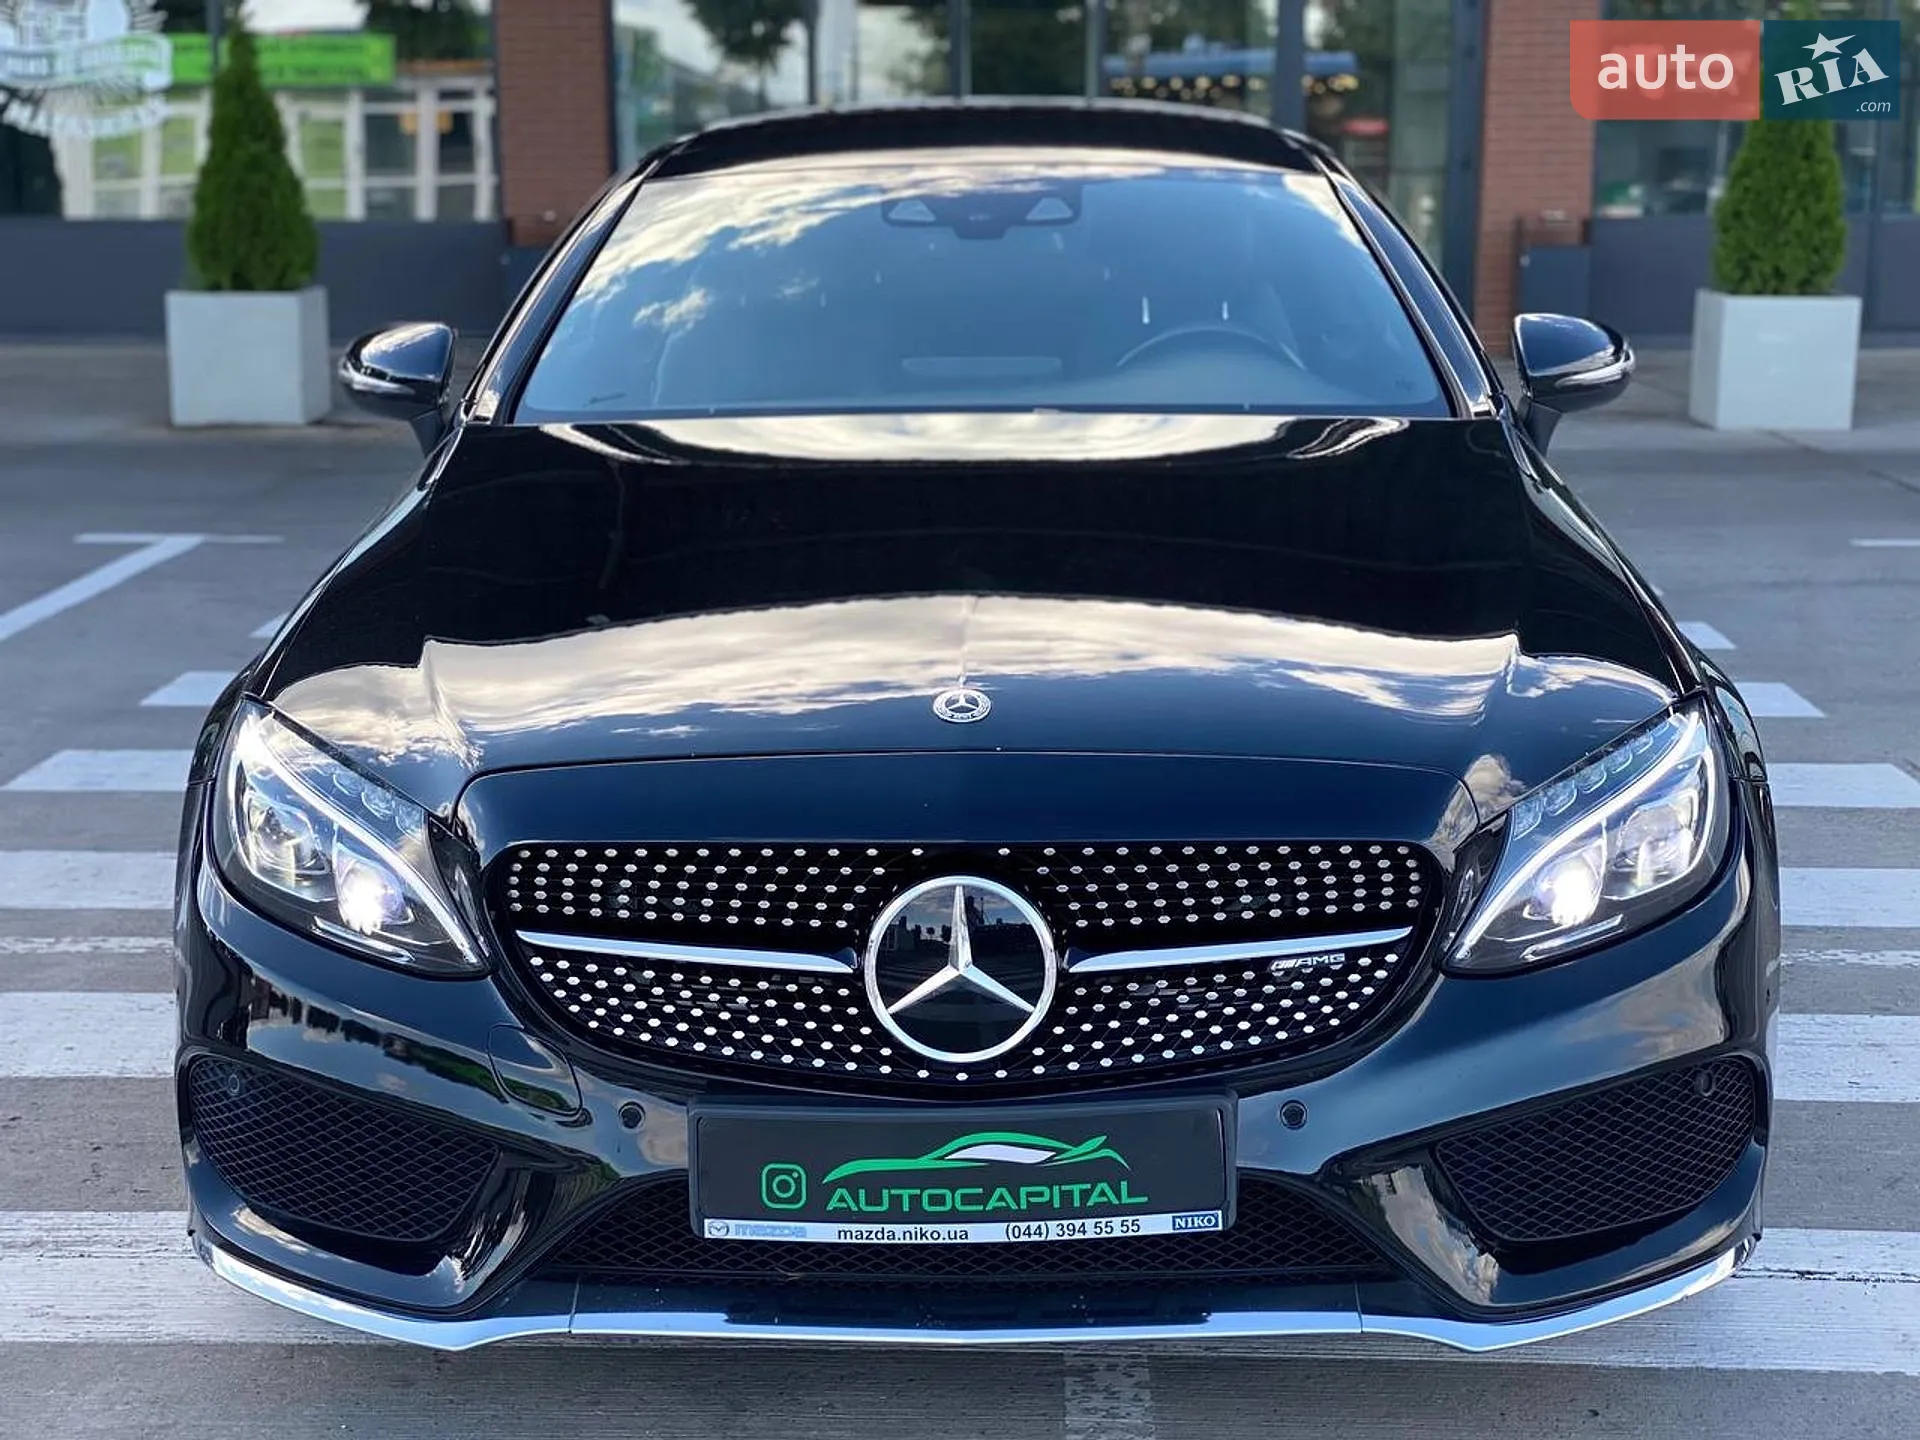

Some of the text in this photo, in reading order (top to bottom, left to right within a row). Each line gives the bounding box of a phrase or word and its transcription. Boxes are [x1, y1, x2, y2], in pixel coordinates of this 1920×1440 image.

[827, 1181, 1148, 1212] AUTOCAPITAL
[1004, 1218, 1141, 1241] (044) 394 55 55
[1174, 1214, 1217, 1230] NIKO
[837, 1226, 969, 1242] mazda.niko.ua
